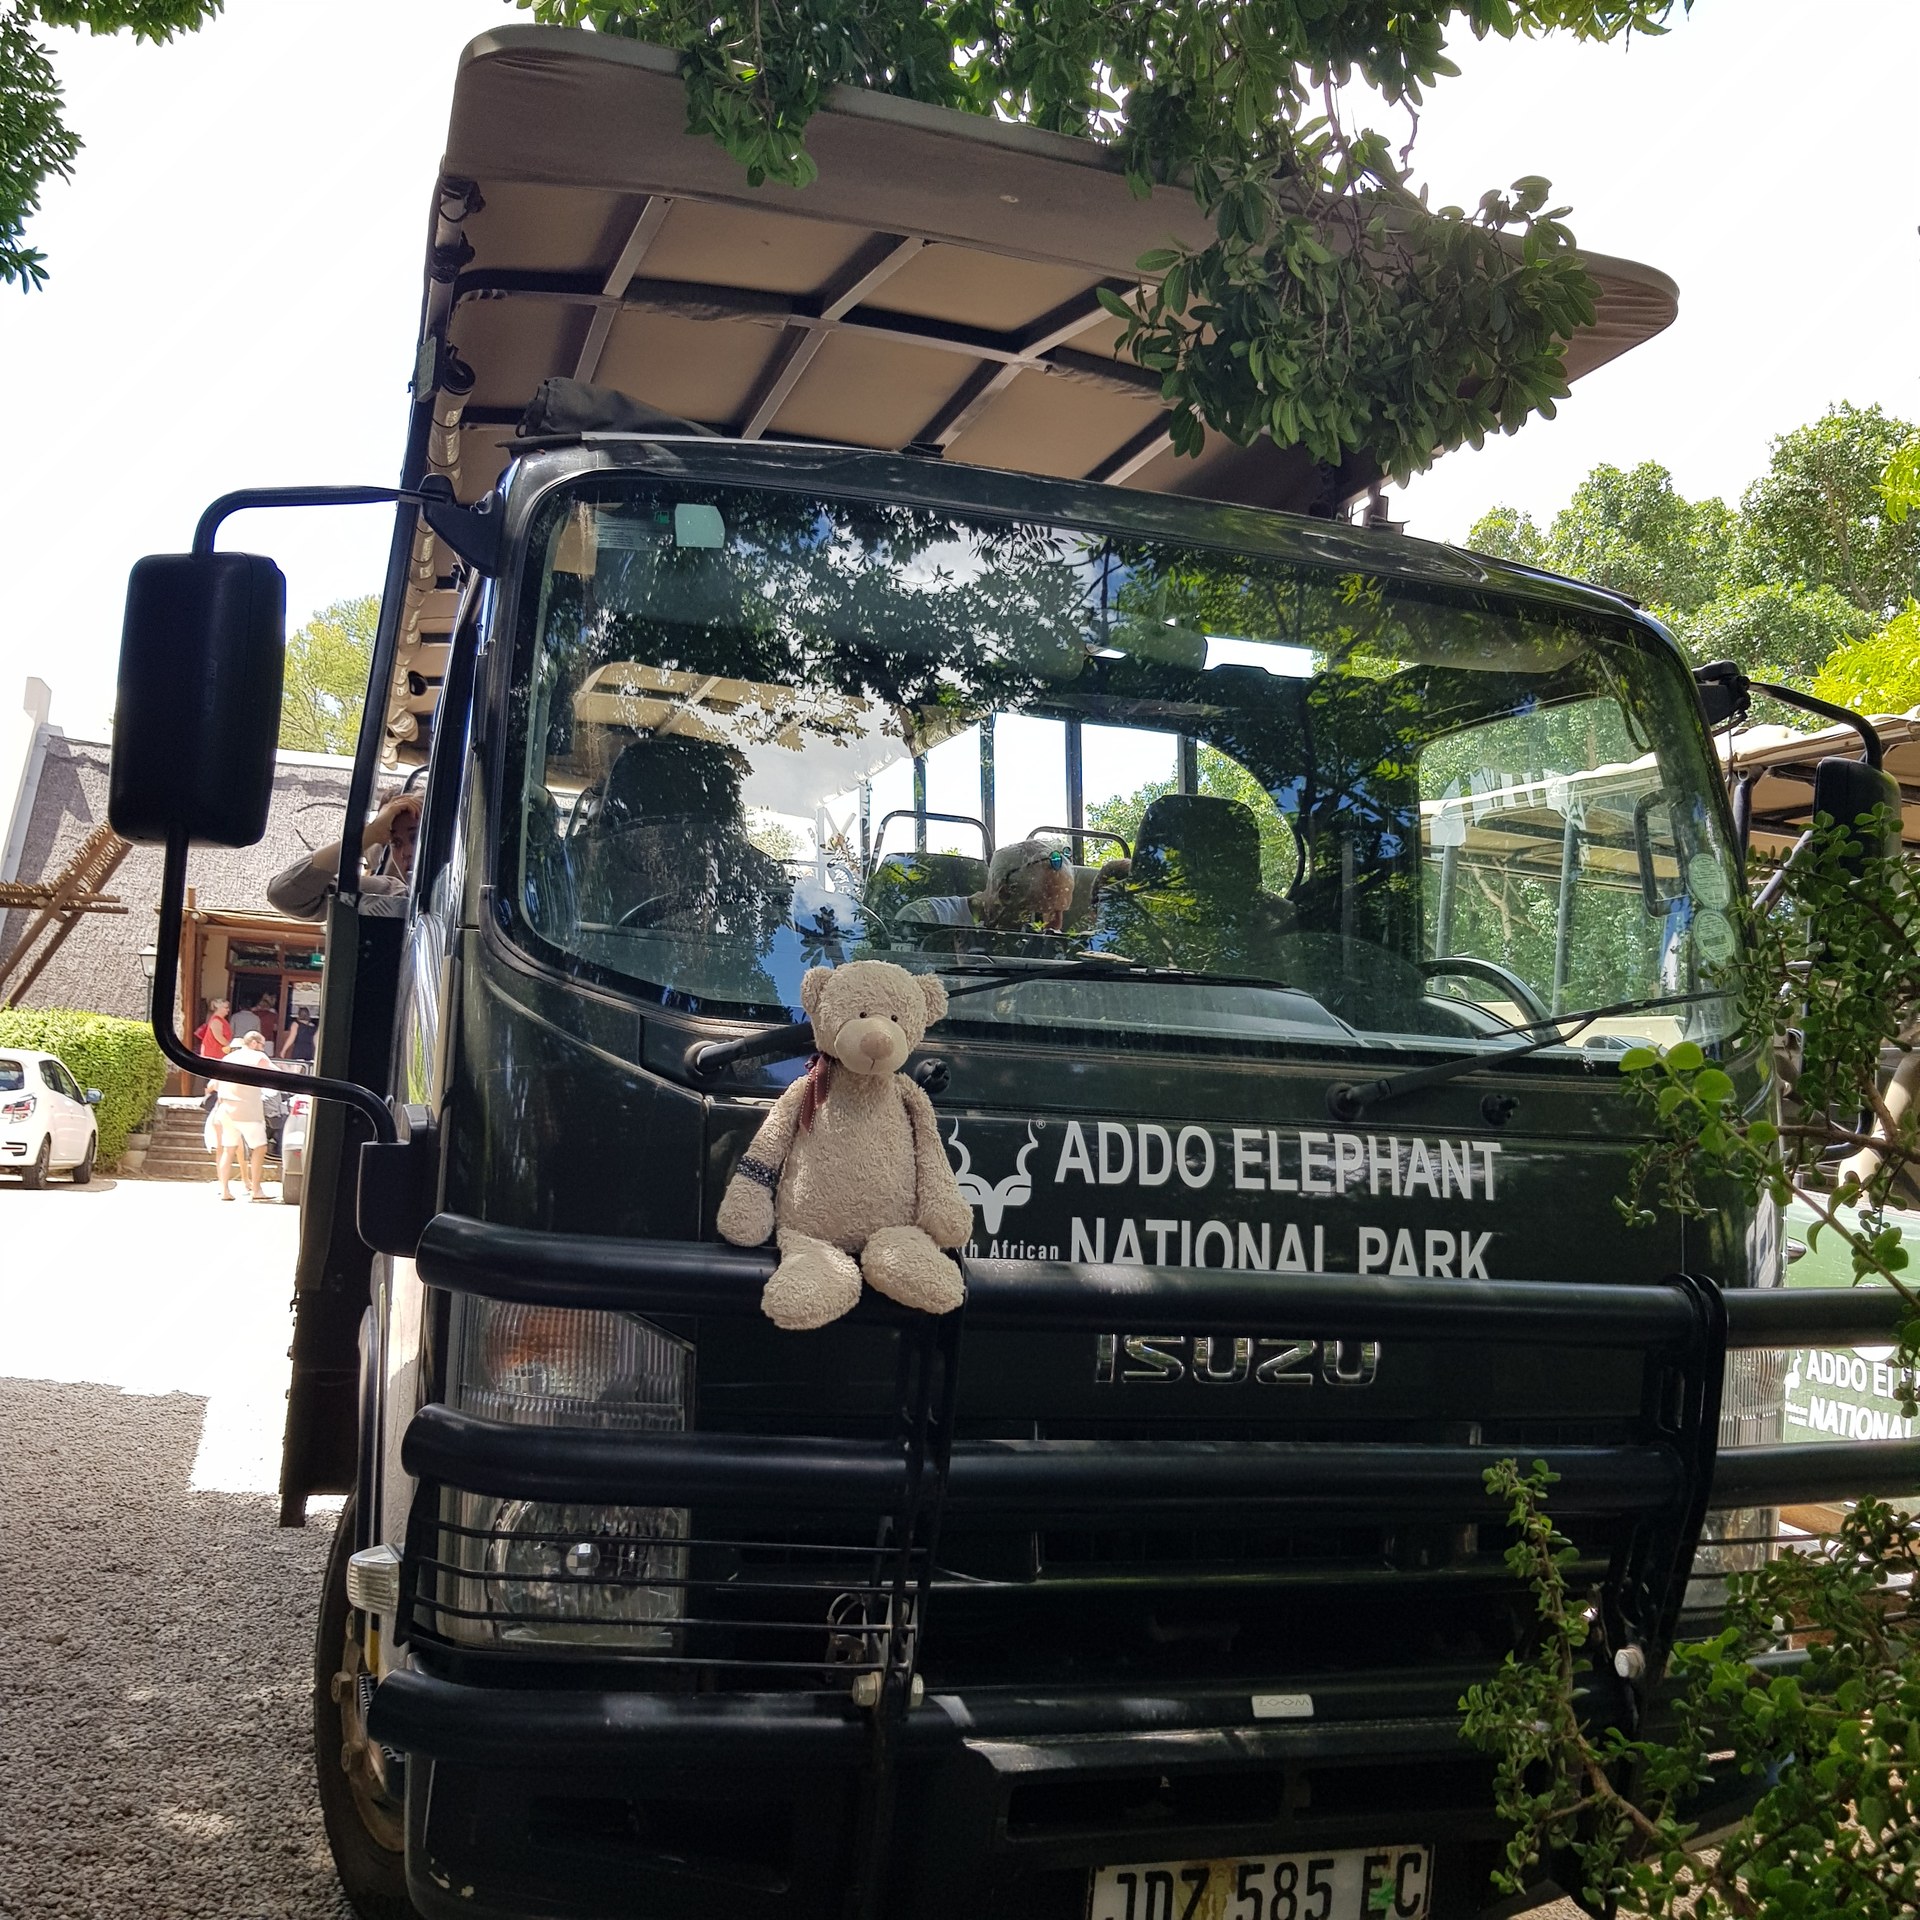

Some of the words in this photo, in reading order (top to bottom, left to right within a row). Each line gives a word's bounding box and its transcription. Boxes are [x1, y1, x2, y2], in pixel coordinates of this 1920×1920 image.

[1054, 1120, 1216, 1189] ADDO
[1232, 1127, 1501, 1201] ELEPHANT
[989, 1239, 1059, 1260] African
[1358, 1226, 1493, 1280] PARK
[1095, 1334, 1381, 1386] ISUZU
[1806, 1349, 1867, 1392] ADDO
[1235, 1859, 1335, 1920] 585
[1360, 1852, 1423, 1920] EC
